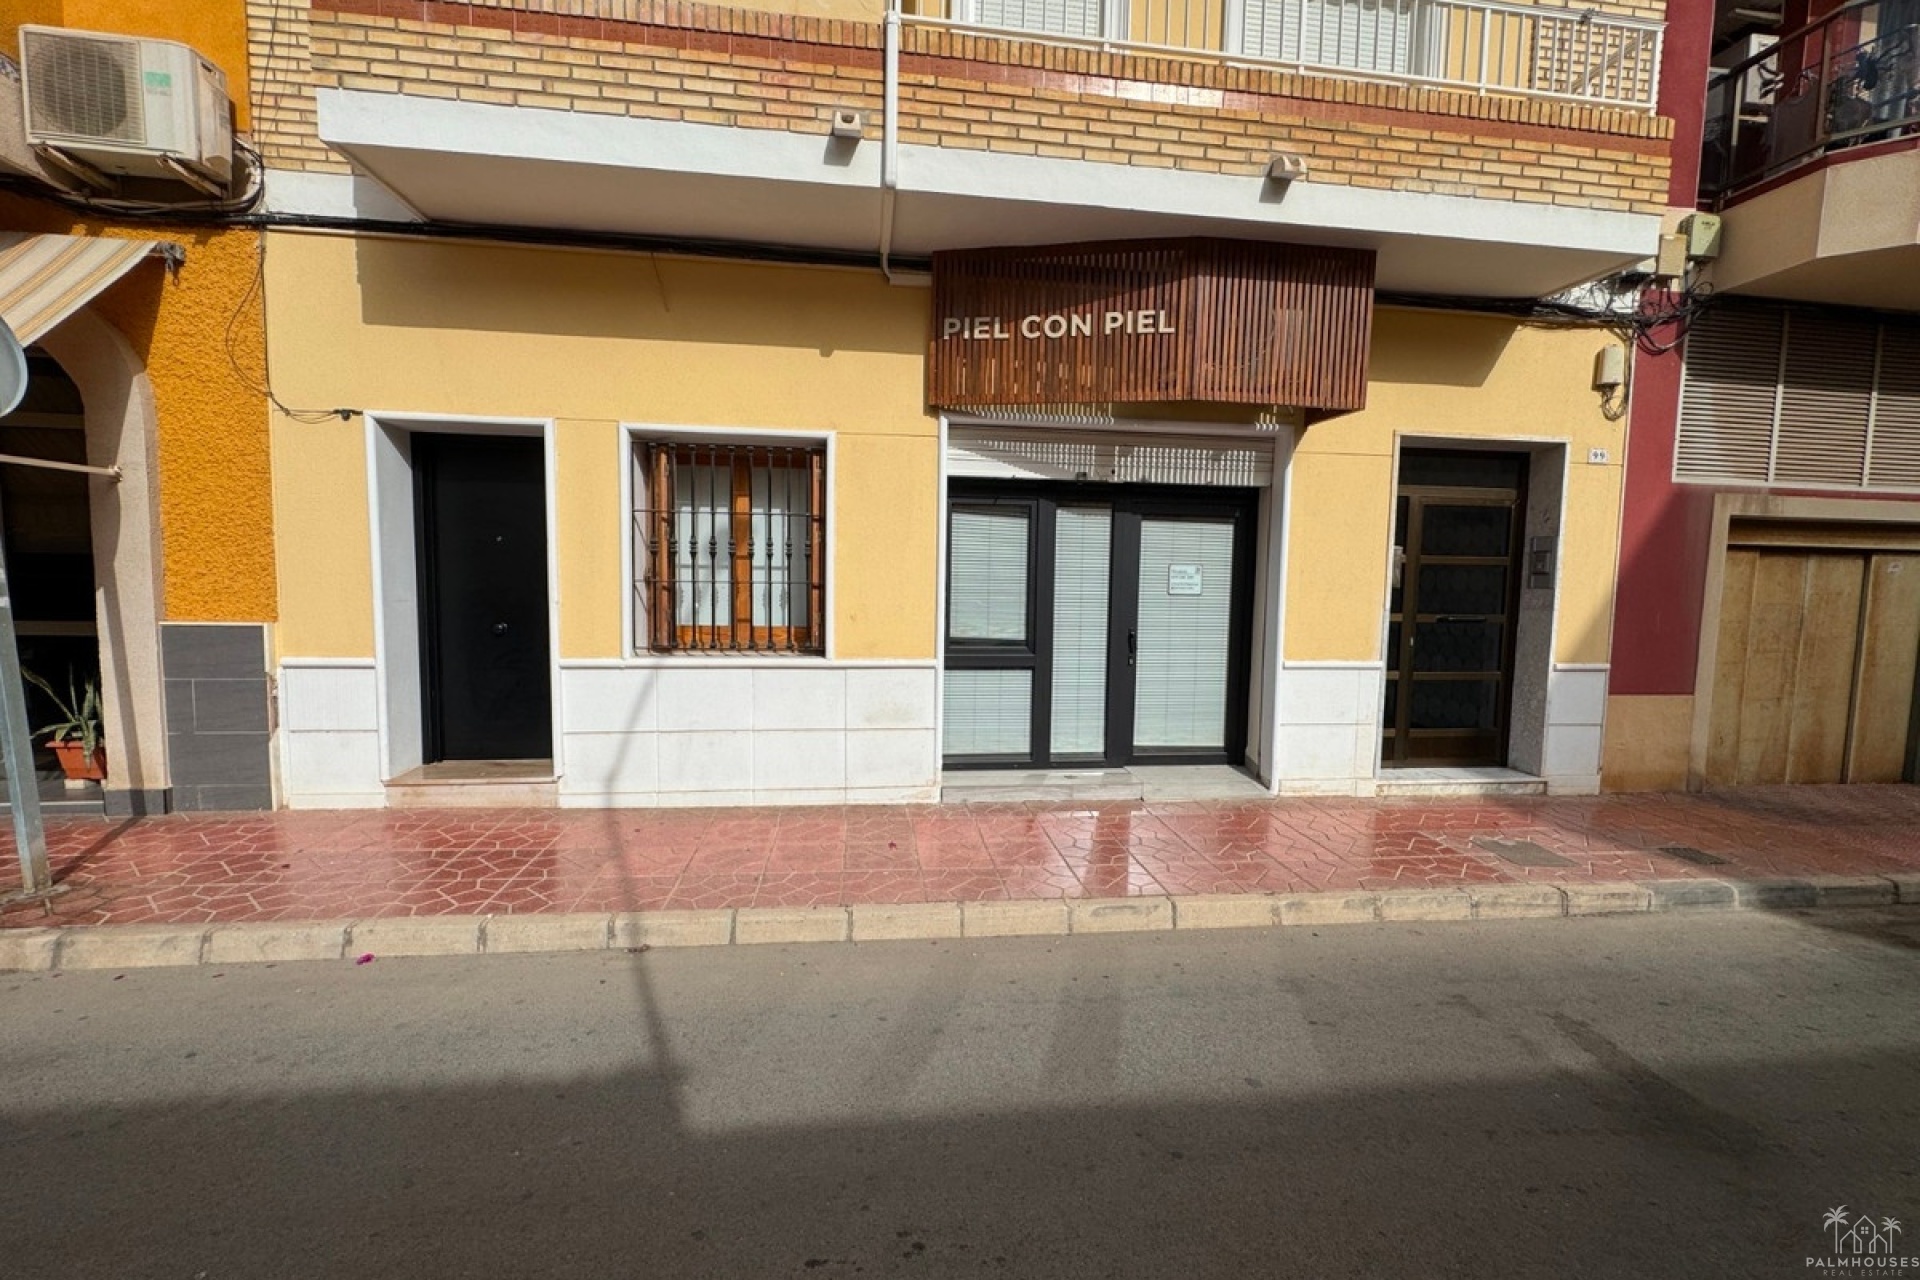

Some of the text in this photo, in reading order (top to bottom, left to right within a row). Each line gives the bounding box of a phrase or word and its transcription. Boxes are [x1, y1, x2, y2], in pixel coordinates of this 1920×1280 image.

[943, 310, 1175, 339] PIEL CON PIEL
